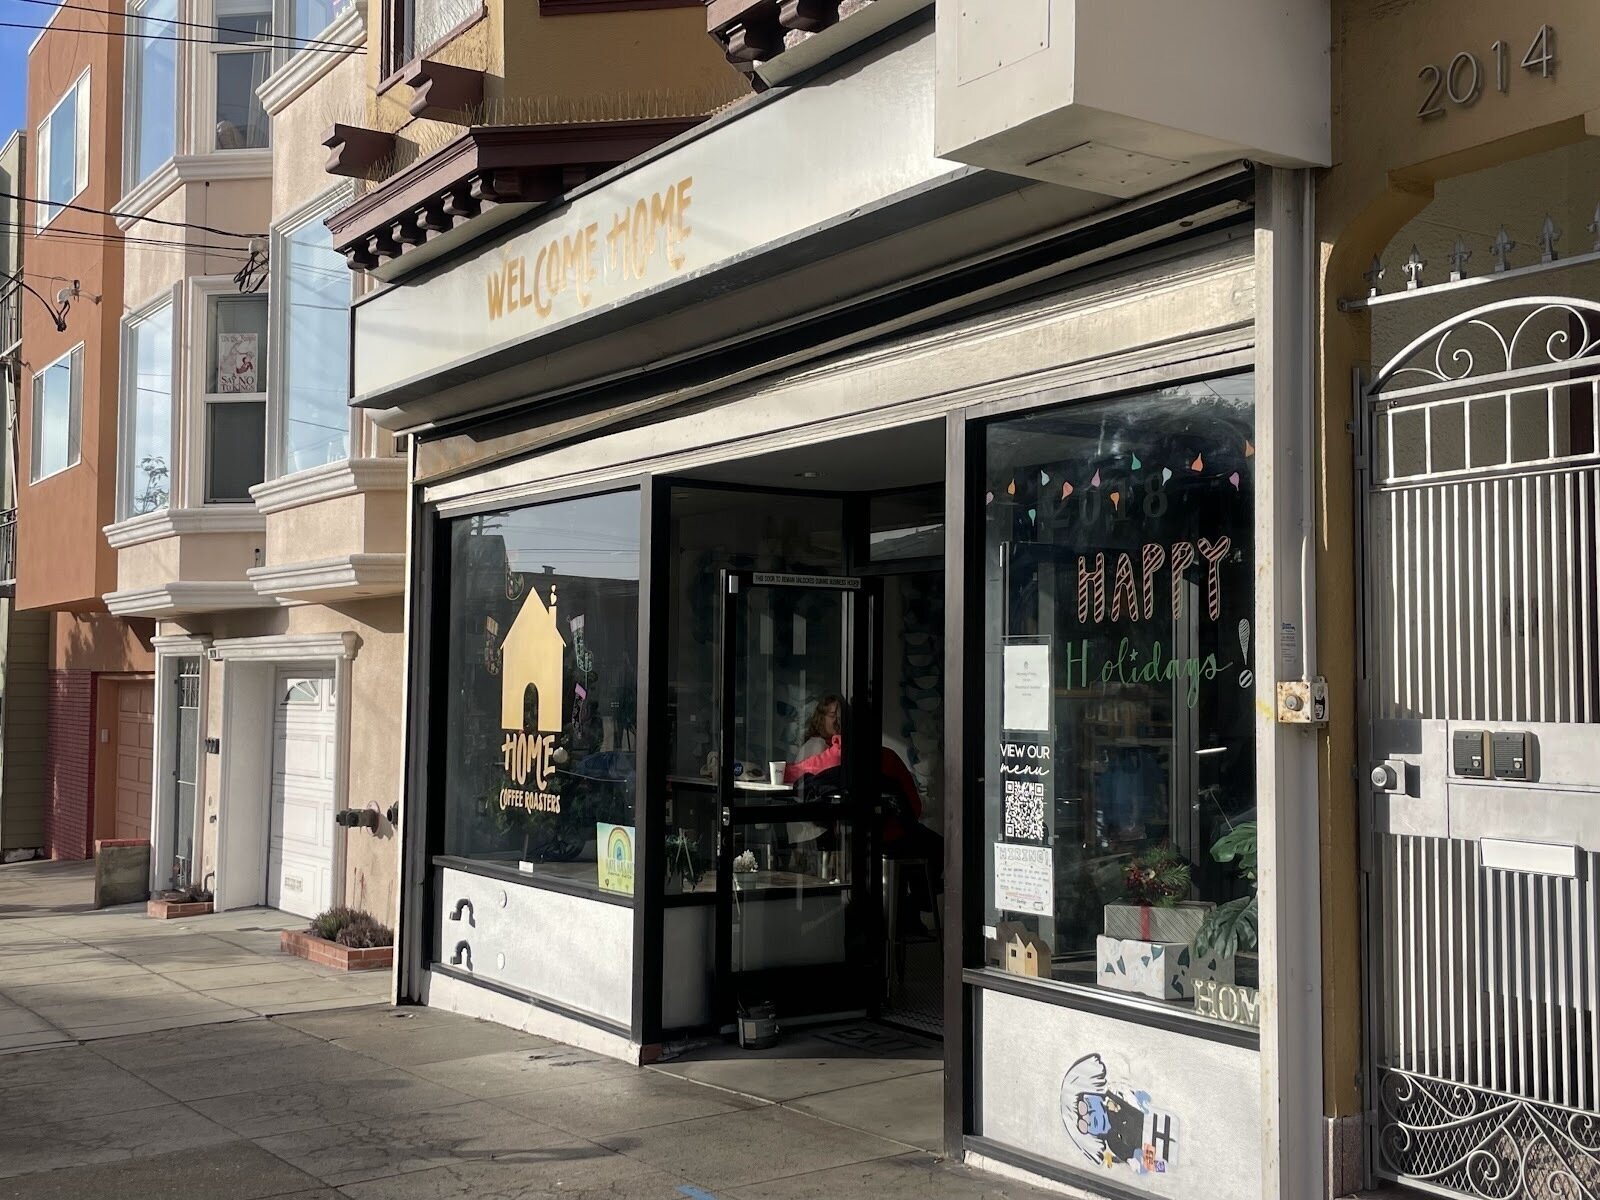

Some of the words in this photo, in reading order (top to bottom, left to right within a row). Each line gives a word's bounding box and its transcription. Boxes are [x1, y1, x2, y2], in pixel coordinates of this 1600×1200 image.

[1416, 24, 1553, 118] 2014
[487, 222, 598, 320] WELCOME
[605, 176, 693, 280] HOME
[221, 375, 237, 384] SAY
[239, 376, 254, 385] NO
[1077, 535, 1231, 623] HAPPY
[502, 733, 556, 791] HOME
[1000, 743, 1026, 758] VIEW
[1027, 745, 1050, 760] OUR
[1000, 763, 1050, 776] menu
[500, 788, 524, 811] COFFEE
[525, 791, 561, 815] ROASTERS
